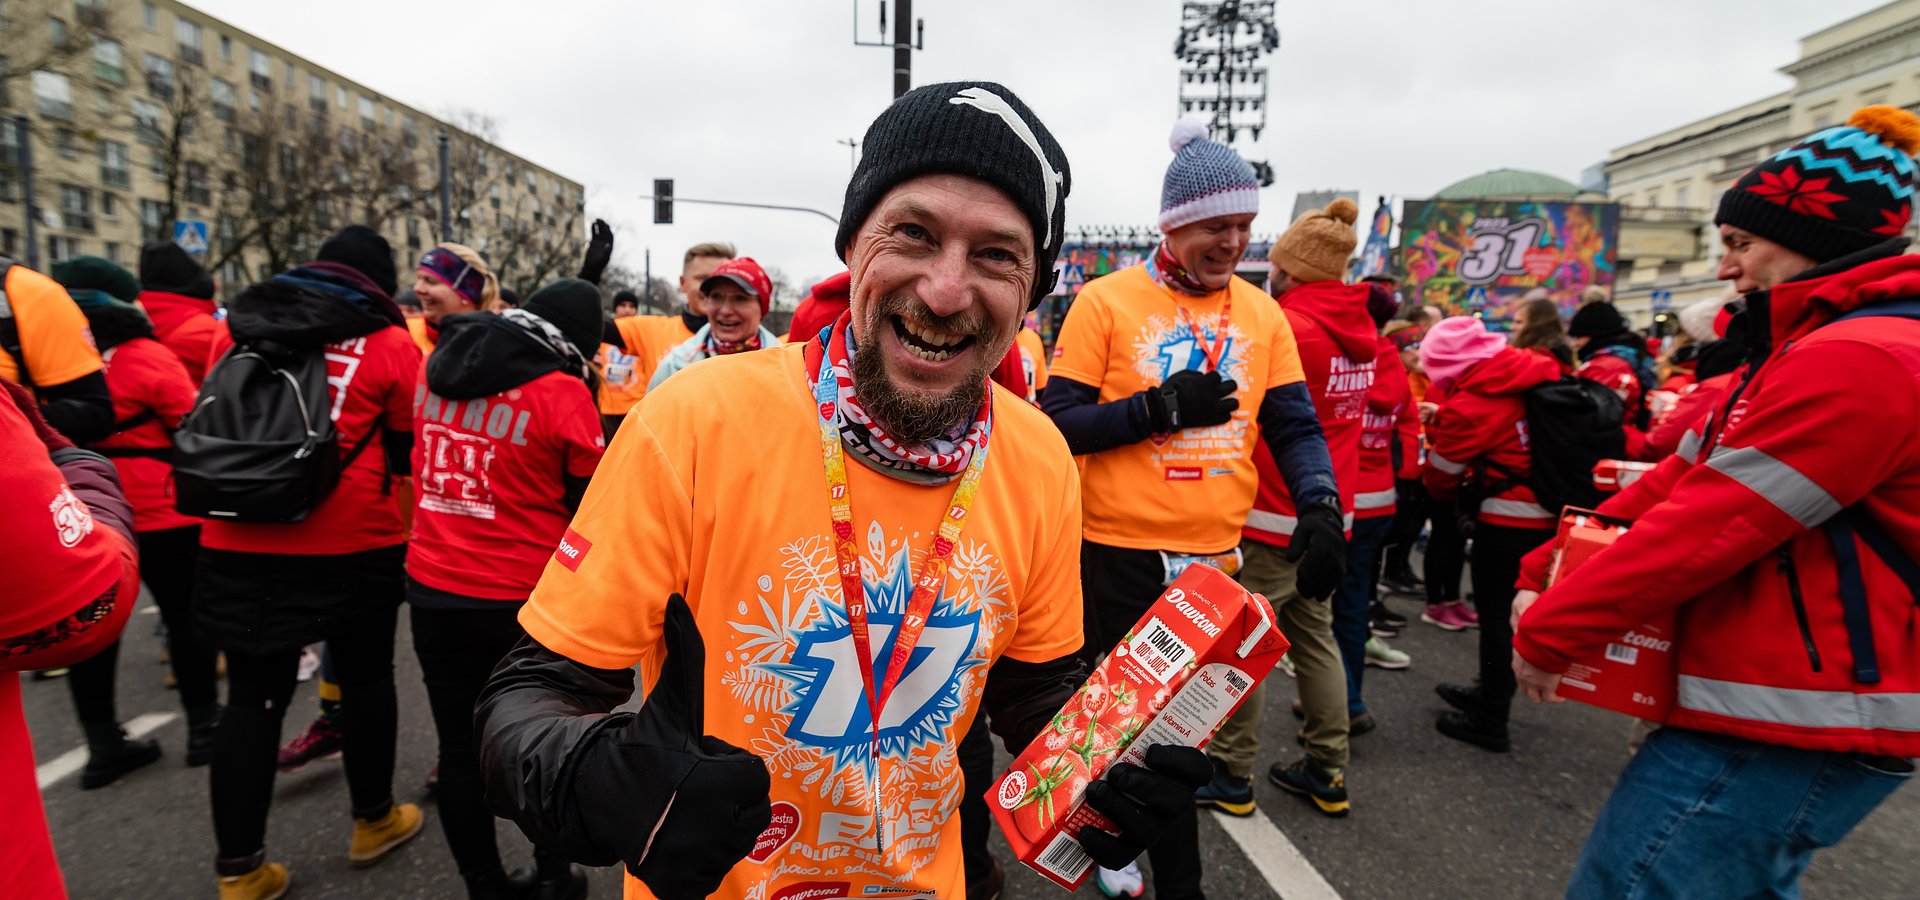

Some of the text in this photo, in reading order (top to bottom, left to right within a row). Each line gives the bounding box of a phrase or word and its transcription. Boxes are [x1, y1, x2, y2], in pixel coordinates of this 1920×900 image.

[1460, 222, 1540, 282] 31
[413, 384, 531, 446] PATROL
[825, 442, 838, 458] 31
[965, 468, 979, 480] 31
[831, 485, 845, 498] 17
[950, 506, 967, 519] 17
[843, 561, 856, 575] 31
[919, 576, 940, 588] 31
[850, 604, 863, 617] 17
[1165, 588, 1221, 638] Dawtona
[905, 615, 923, 628] 17
[1147, 625, 1186, 663] TOMATO
[1621, 630, 1672, 652] tona
[1135, 642, 1171, 676] 100% JUICE
[801, 623, 975, 737] 17
[1124, 667, 1143, 686] lycopene
[1135, 664, 1155, 686] potassium
[1199, 670, 1217, 688] Potas
[1223, 669, 1248, 692] POMIDOR
[1224, 684, 1233, 693] SOK
[1162, 712, 1192, 738] Witamina A
[790, 841, 850, 861] POLICZ
[854, 849, 882, 866] SIĘ
[884, 851, 895, 867] Z
